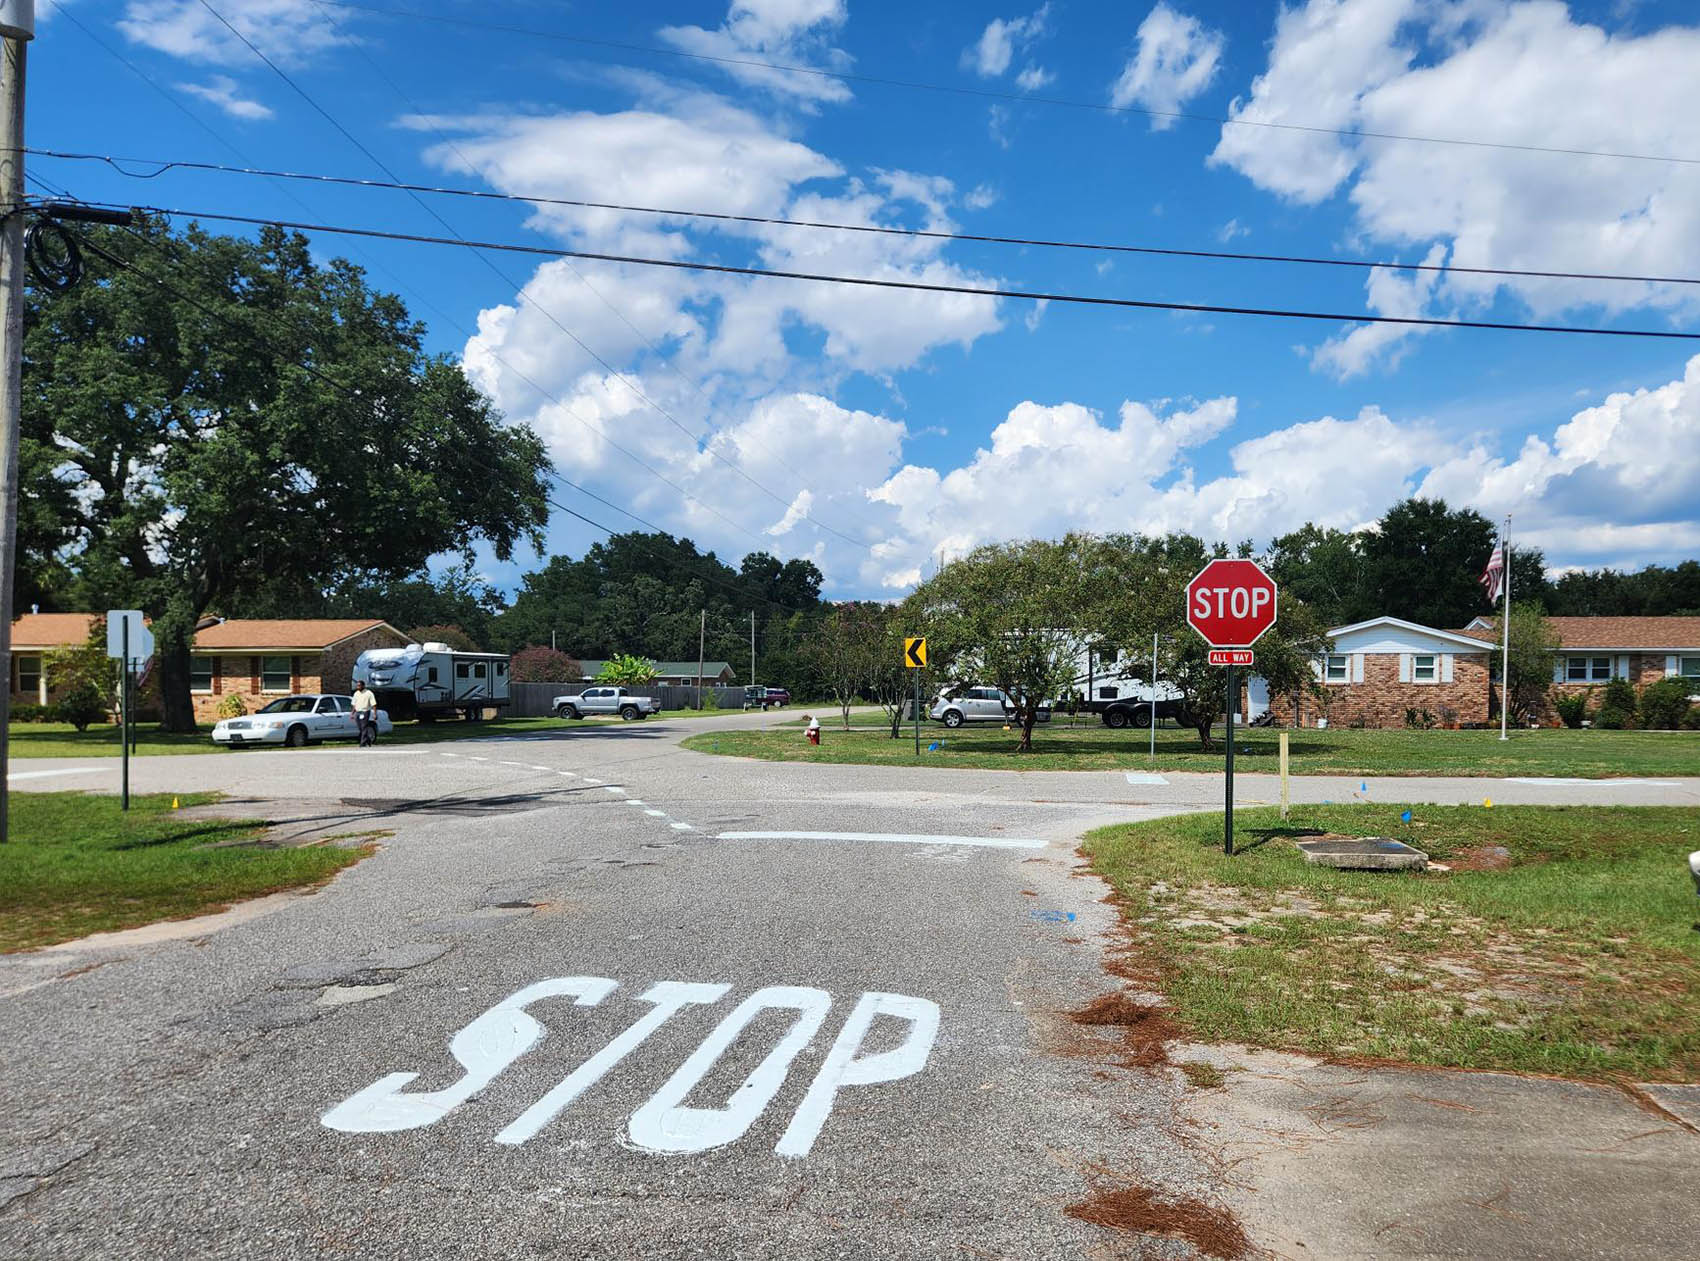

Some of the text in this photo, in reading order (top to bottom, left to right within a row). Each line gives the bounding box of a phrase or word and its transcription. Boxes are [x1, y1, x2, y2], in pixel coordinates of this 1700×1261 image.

[1193, 587, 1270, 618] STOP
[1212, 653, 1249, 662] ALL WAY
[320, 976, 940, 1158] STOP
